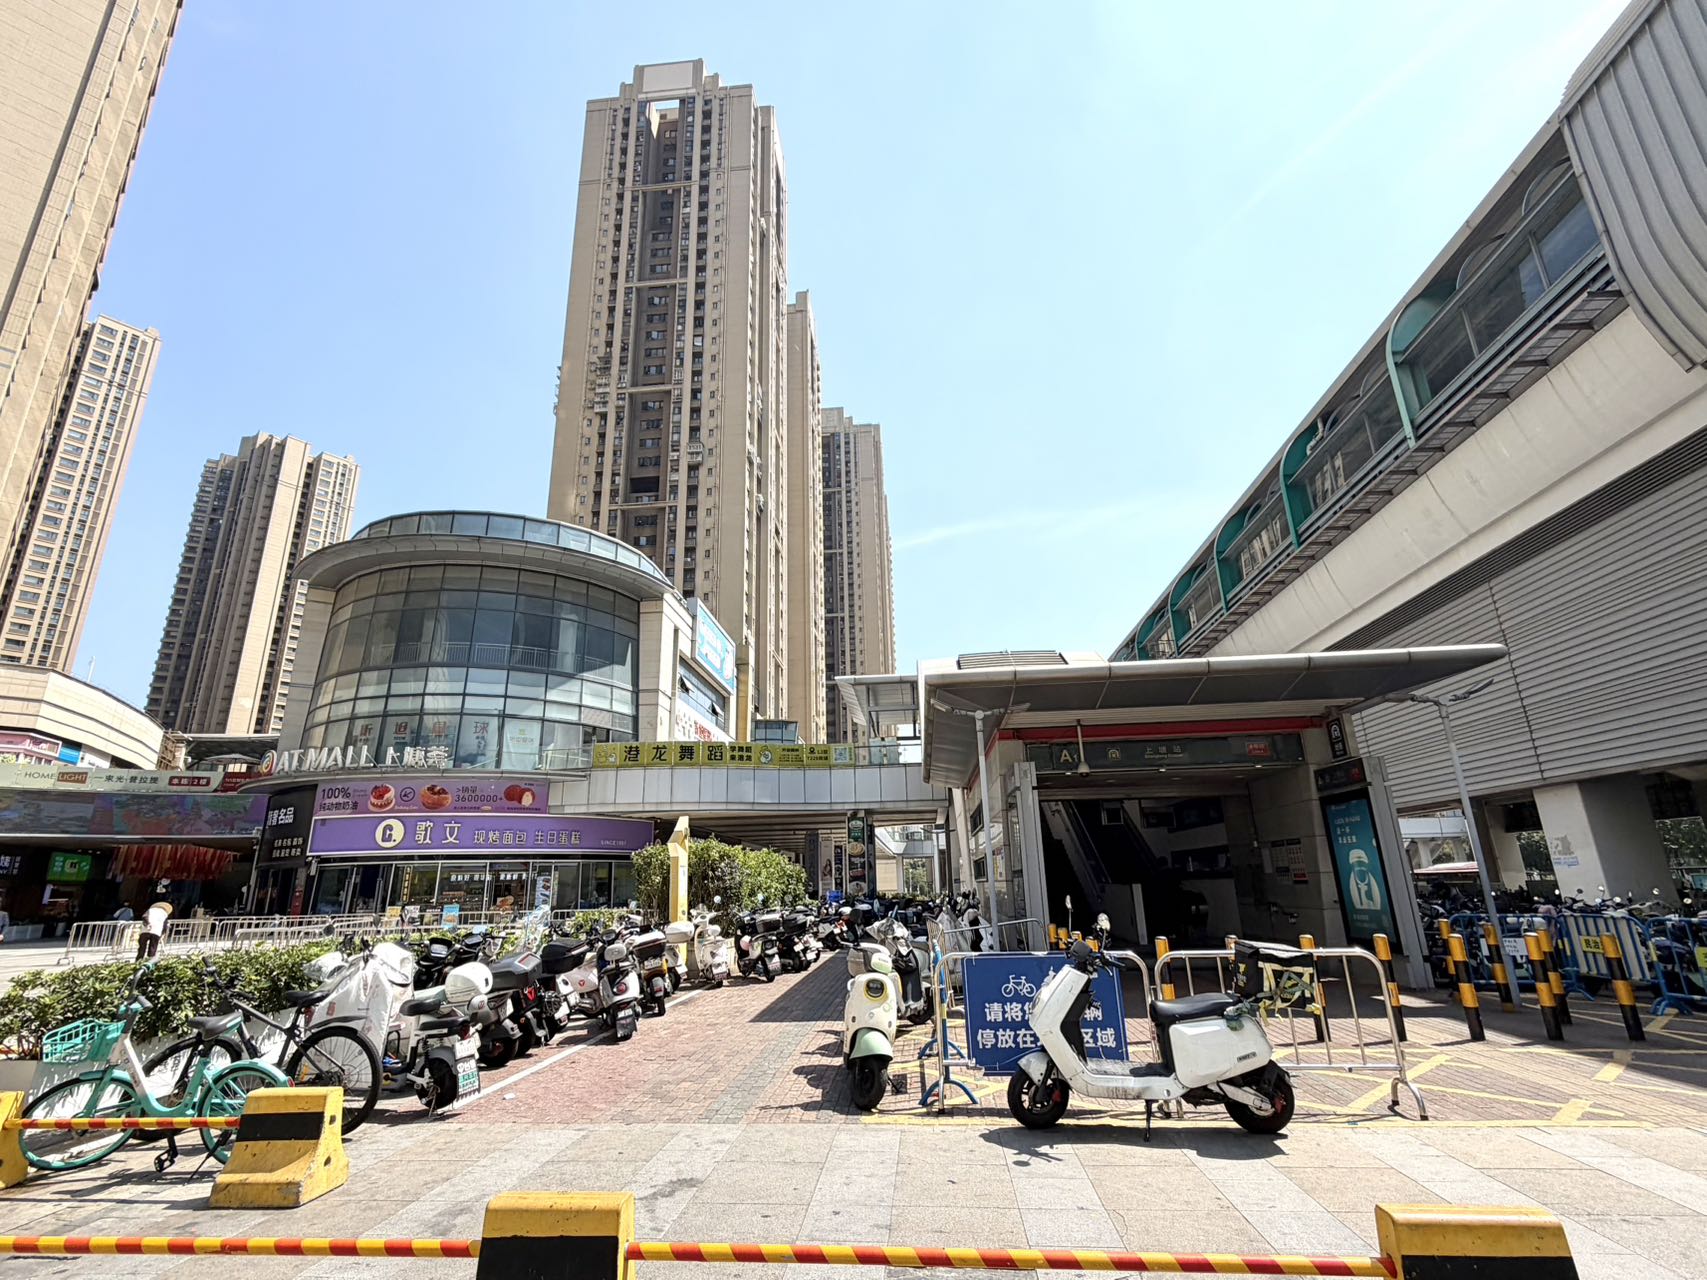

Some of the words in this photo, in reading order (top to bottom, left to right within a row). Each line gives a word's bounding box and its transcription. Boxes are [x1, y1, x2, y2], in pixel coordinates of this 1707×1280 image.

[303, 744, 374, 771] MALL
[623, 744, 723, 762] 港龙舞蹈
[24, 771, 57, 780] HOME
[59, 773, 86, 781] LIGHT
[321, 786, 351, 800] 100%
[415, 820, 462, 845] 歌文
[473, 830, 527, 845] 现烤面包
[534, 830, 582, 845] 生日蛋糕
[976, 1027, 1116, 1049] 停放在区域
